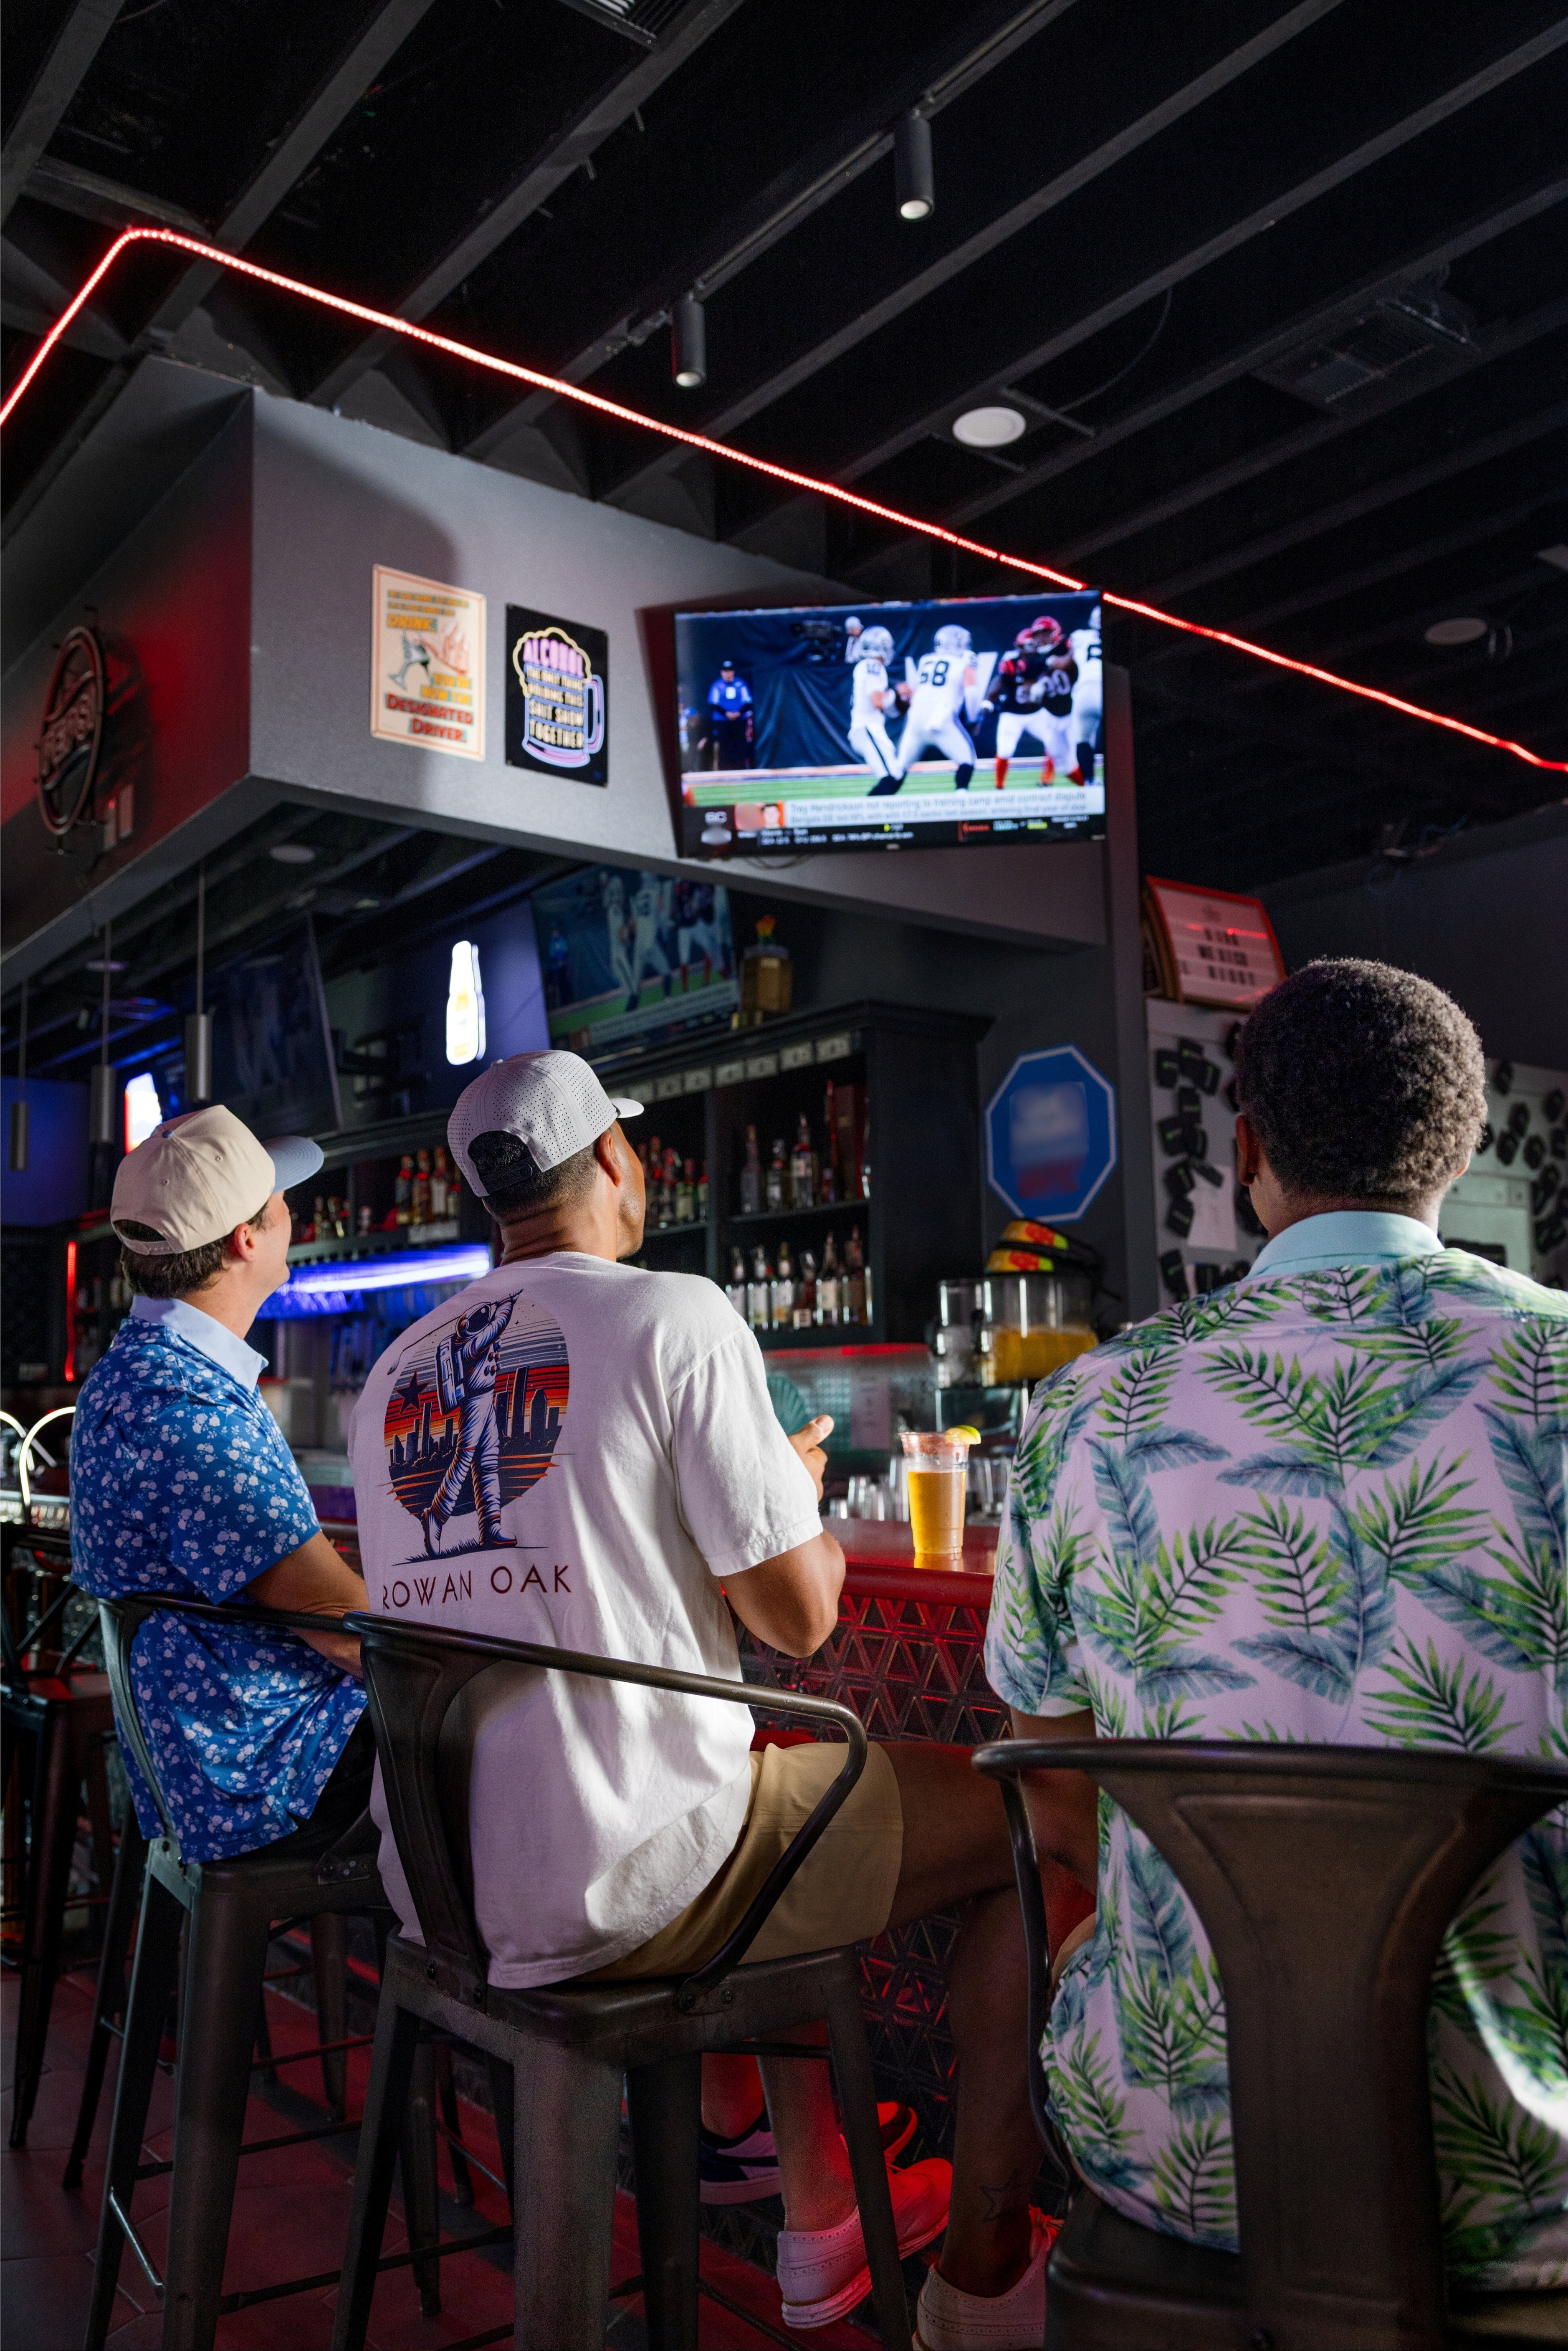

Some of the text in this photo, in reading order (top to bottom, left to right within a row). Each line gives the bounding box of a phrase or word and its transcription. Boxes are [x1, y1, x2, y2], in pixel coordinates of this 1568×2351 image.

[523, 638, 584, 677] ALCOHOL
[919, 660, 950, 687] 58
[386, 692, 473, 725] DESIGNATED
[530, 699, 584, 727] SHIT SHOW
[529, 719, 584, 749] TOGETHER
[383, 1564, 572, 1610] ROWAN OAK
